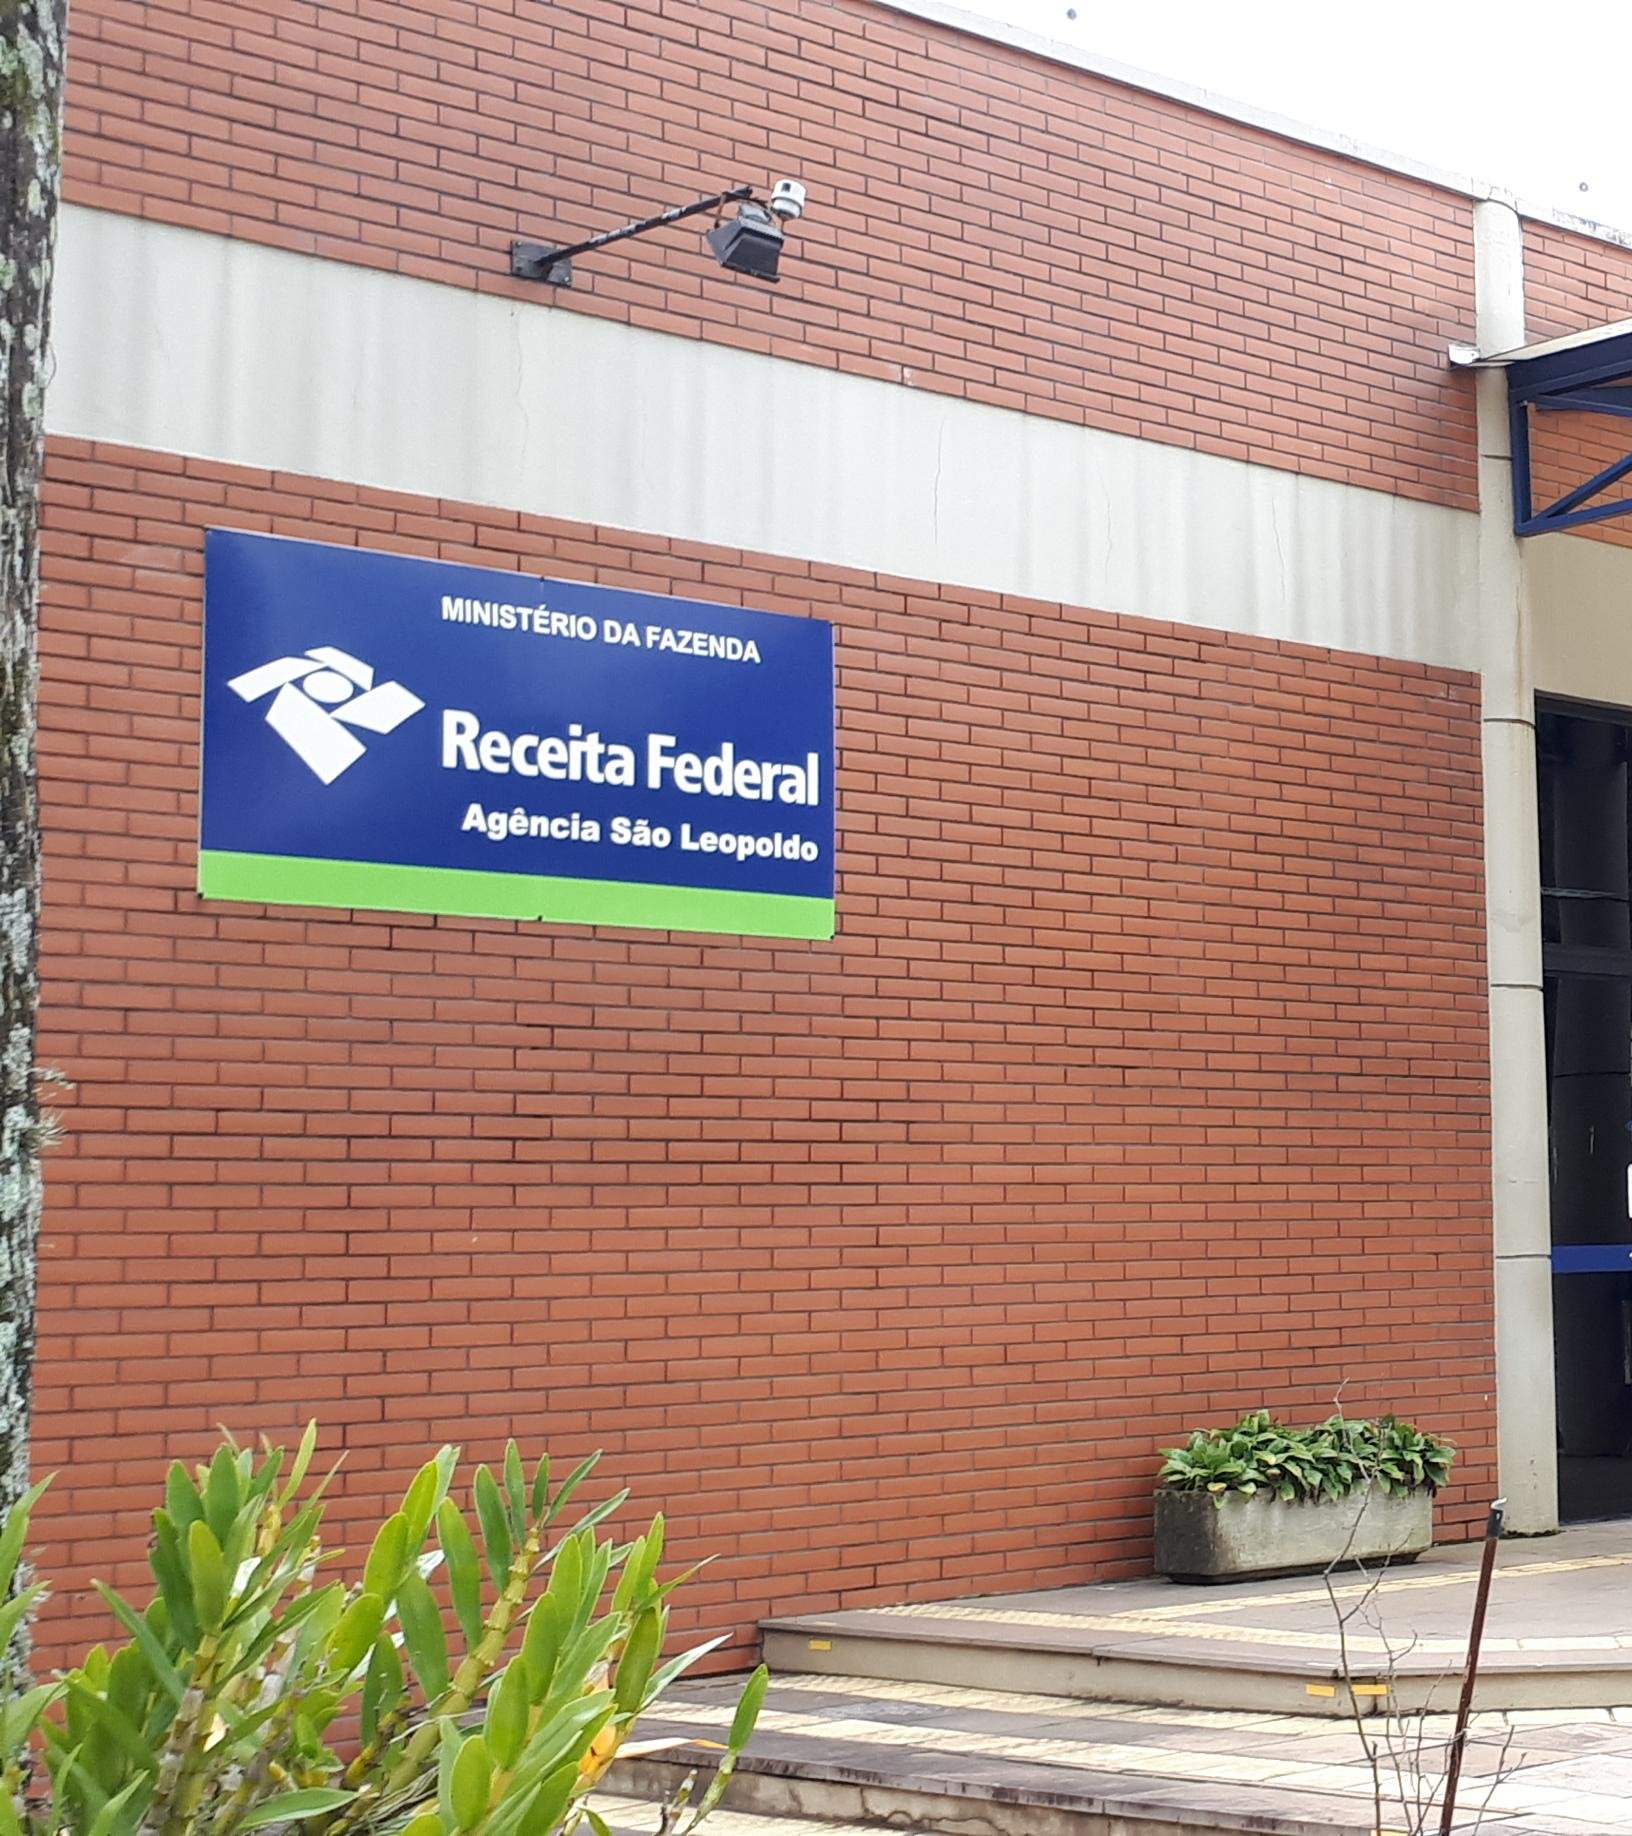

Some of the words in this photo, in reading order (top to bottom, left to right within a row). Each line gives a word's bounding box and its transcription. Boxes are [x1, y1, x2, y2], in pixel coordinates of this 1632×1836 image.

[441, 595, 597, 641] MINISTÉRIO
[603, 619, 641, 647] DA
[645, 625, 761, 664] FAZENDA
[442, 709, 635, 787] Receita
[647, 733, 819, 806] Federal
[461, 802, 600, 842] Agência
[610, 815, 671, 848] São
[680, 823, 819, 862] Leopoldo
